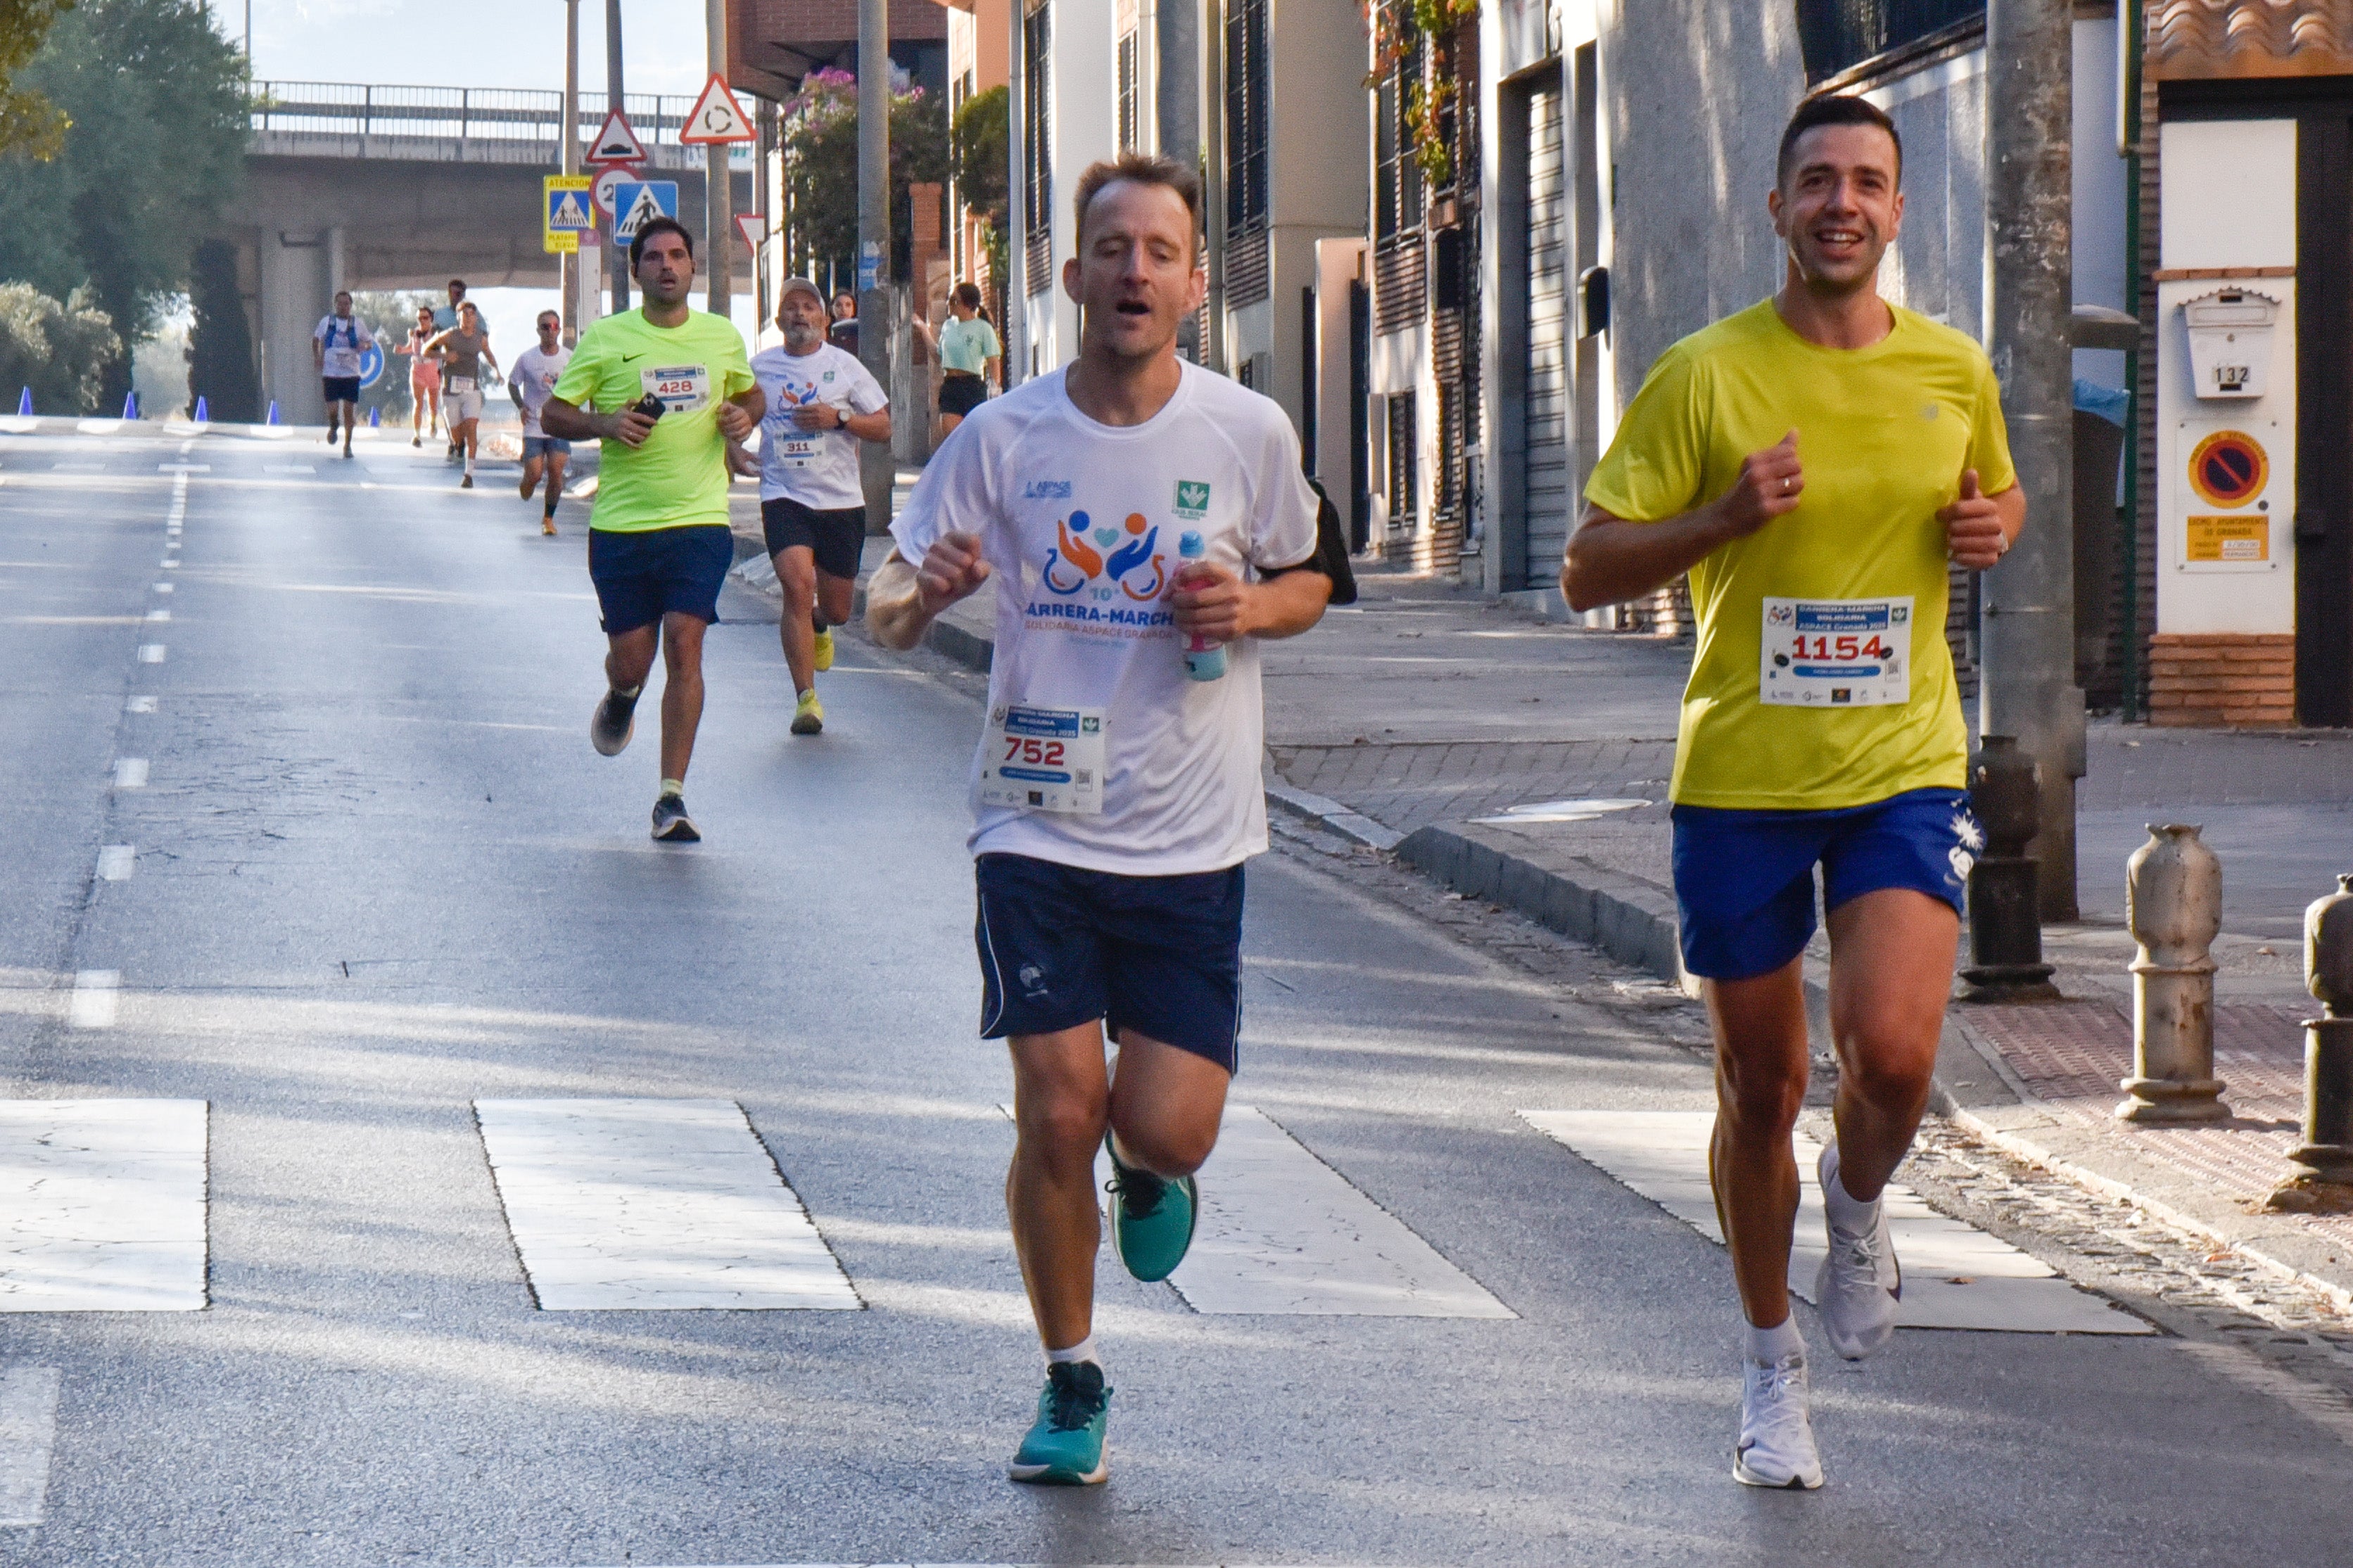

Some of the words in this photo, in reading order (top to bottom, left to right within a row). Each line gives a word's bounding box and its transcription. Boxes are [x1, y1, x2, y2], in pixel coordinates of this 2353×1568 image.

[603, 183, 614, 202] 2
[2215, 366, 2249, 382] 132
[659, 381, 692, 393] 428
[787, 442, 809, 452] 311
[1025, 602, 1174, 625] ARRERA-MARCH
[1792, 635, 1882, 661] 1154
[1004, 737, 1065, 766] 752
